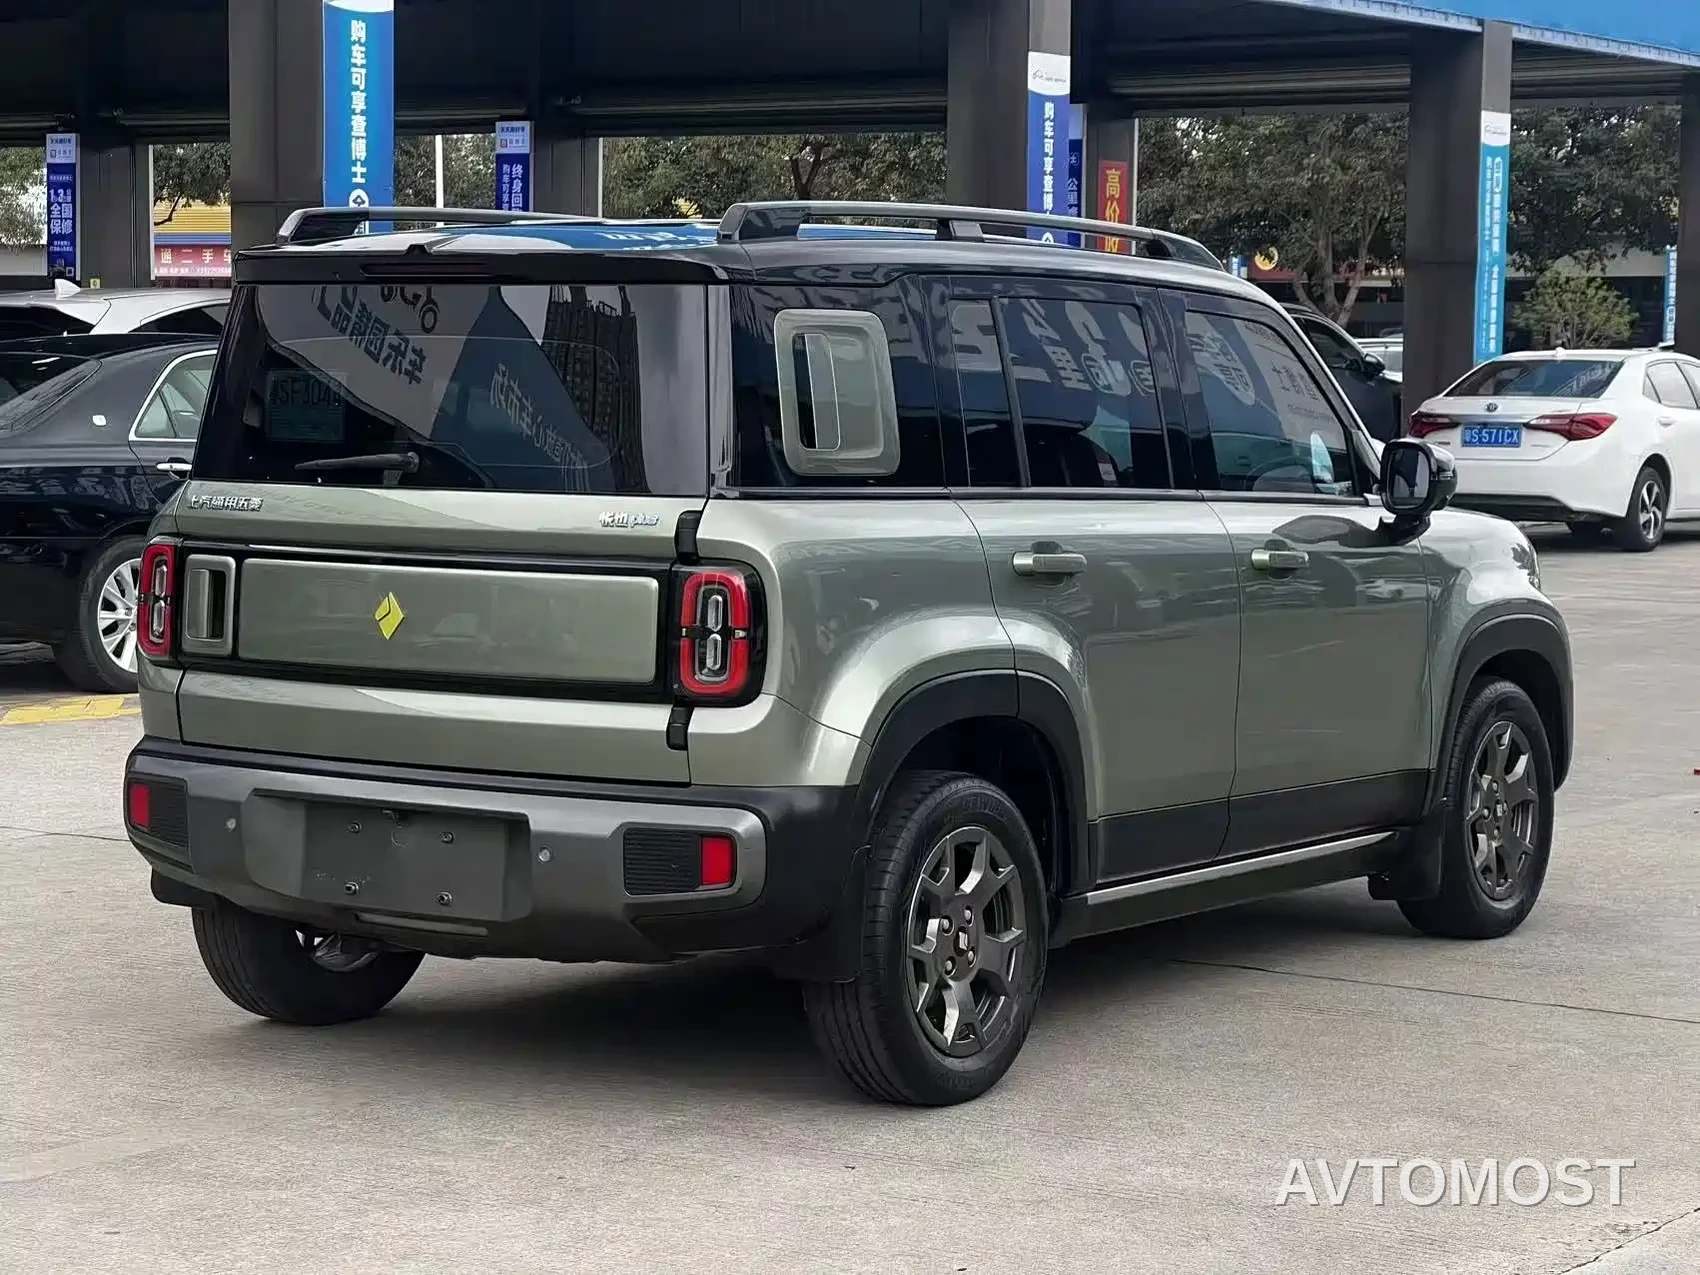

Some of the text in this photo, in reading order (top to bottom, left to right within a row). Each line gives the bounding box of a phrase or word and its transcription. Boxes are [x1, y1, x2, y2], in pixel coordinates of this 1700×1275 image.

[351, 20, 367, 184] 购车可享查博士
[1043, 102, 1055, 216] 购车可享查博
[511, 163, 523, 212] 终身回
[50, 203, 73, 218] 全国
[50, 219, 73, 234] 保修
[190, 494, 263, 511] 上汽通用五菱
